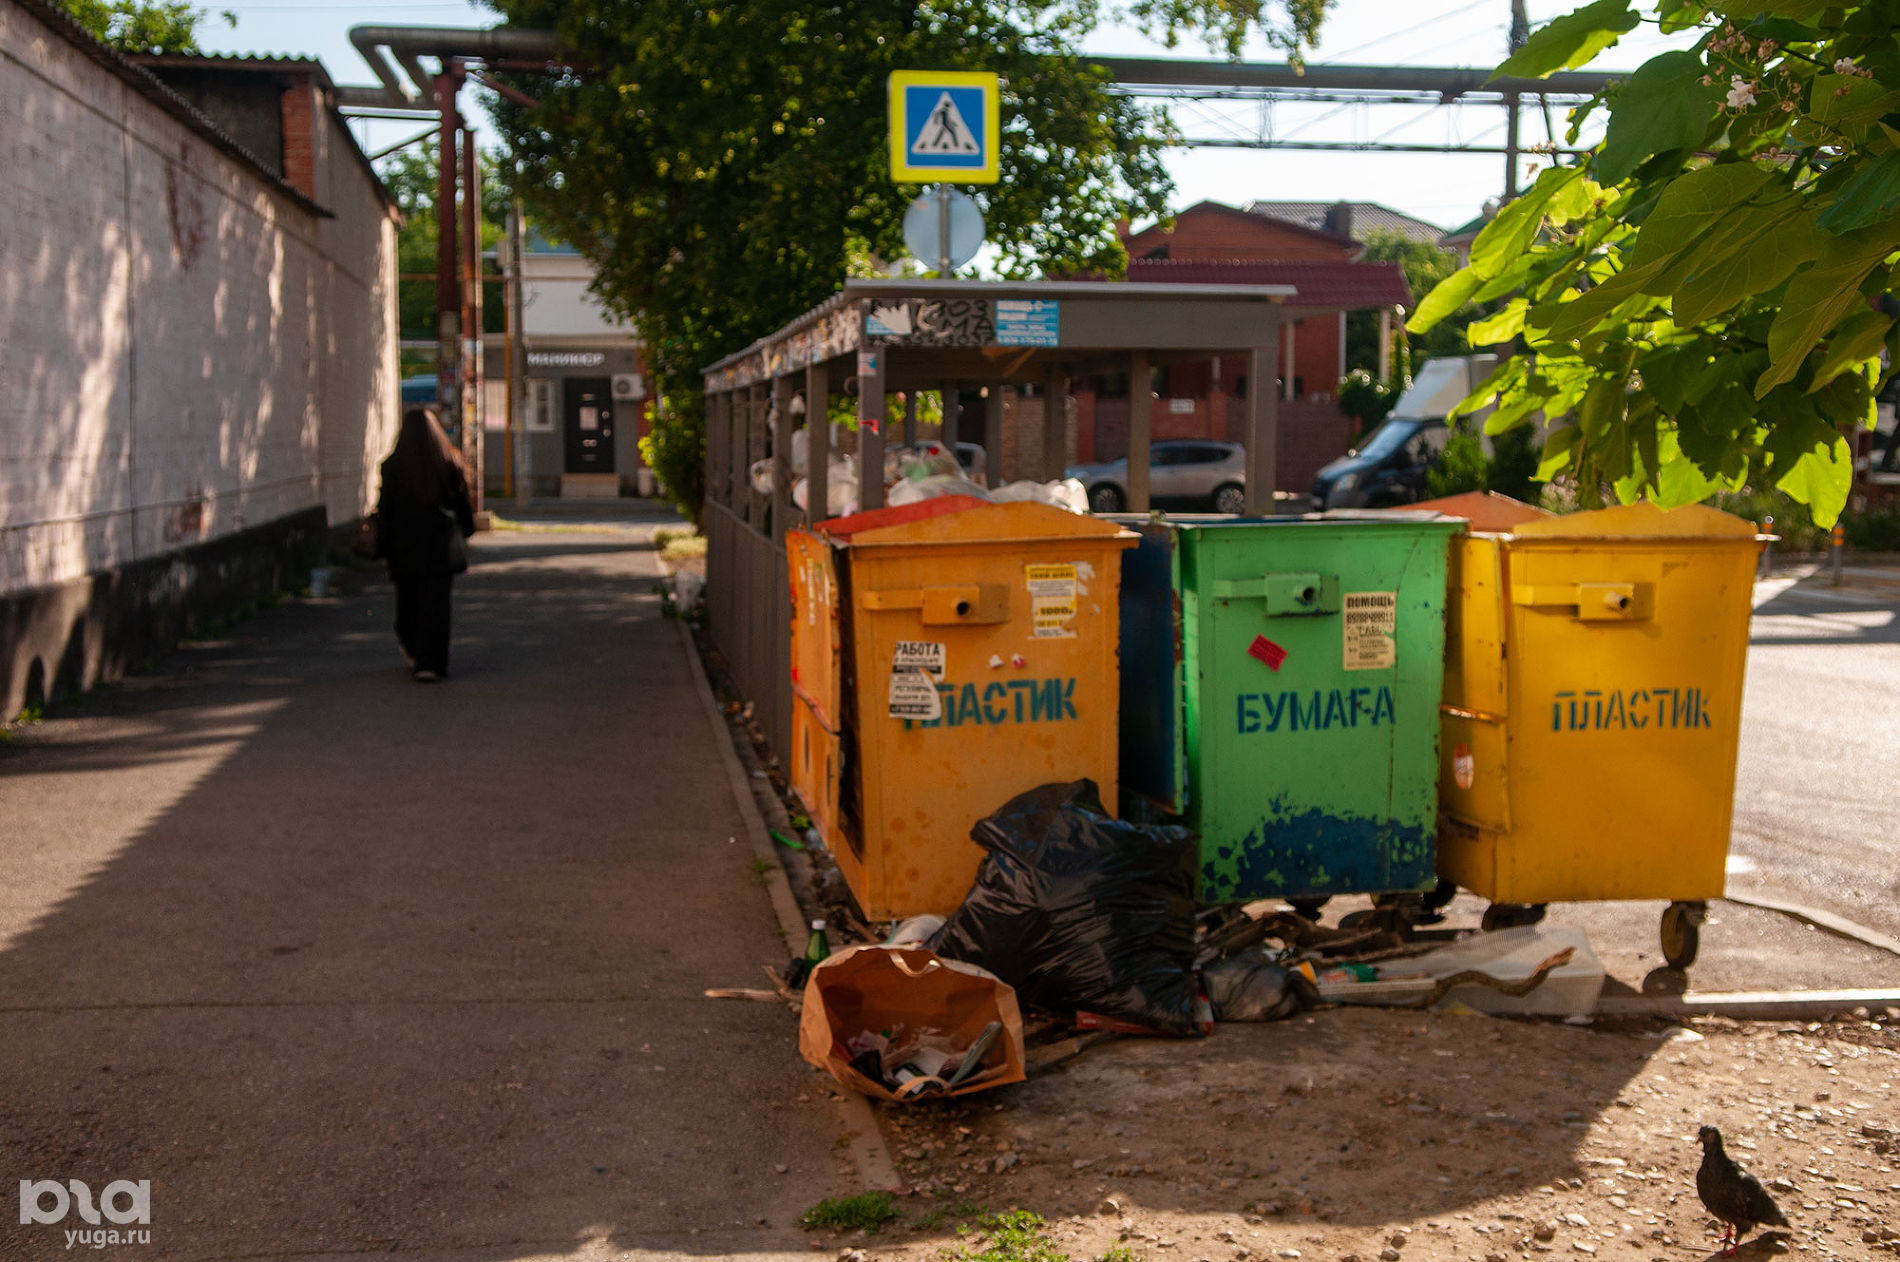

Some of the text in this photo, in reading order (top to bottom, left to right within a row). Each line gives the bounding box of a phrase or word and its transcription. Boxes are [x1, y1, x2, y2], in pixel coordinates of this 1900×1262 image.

[527, 352, 605, 367] МАНИКЮР
[1347, 595, 1394, 608] ПОМОЩЬ
[895, 642, 940, 656] РАБОТА
[904, 677, 1077, 731] ЛАСТИК
[1236, 685, 1396, 734] БУМАГА
[1552, 687, 1712, 732] ПЛАСТИК
